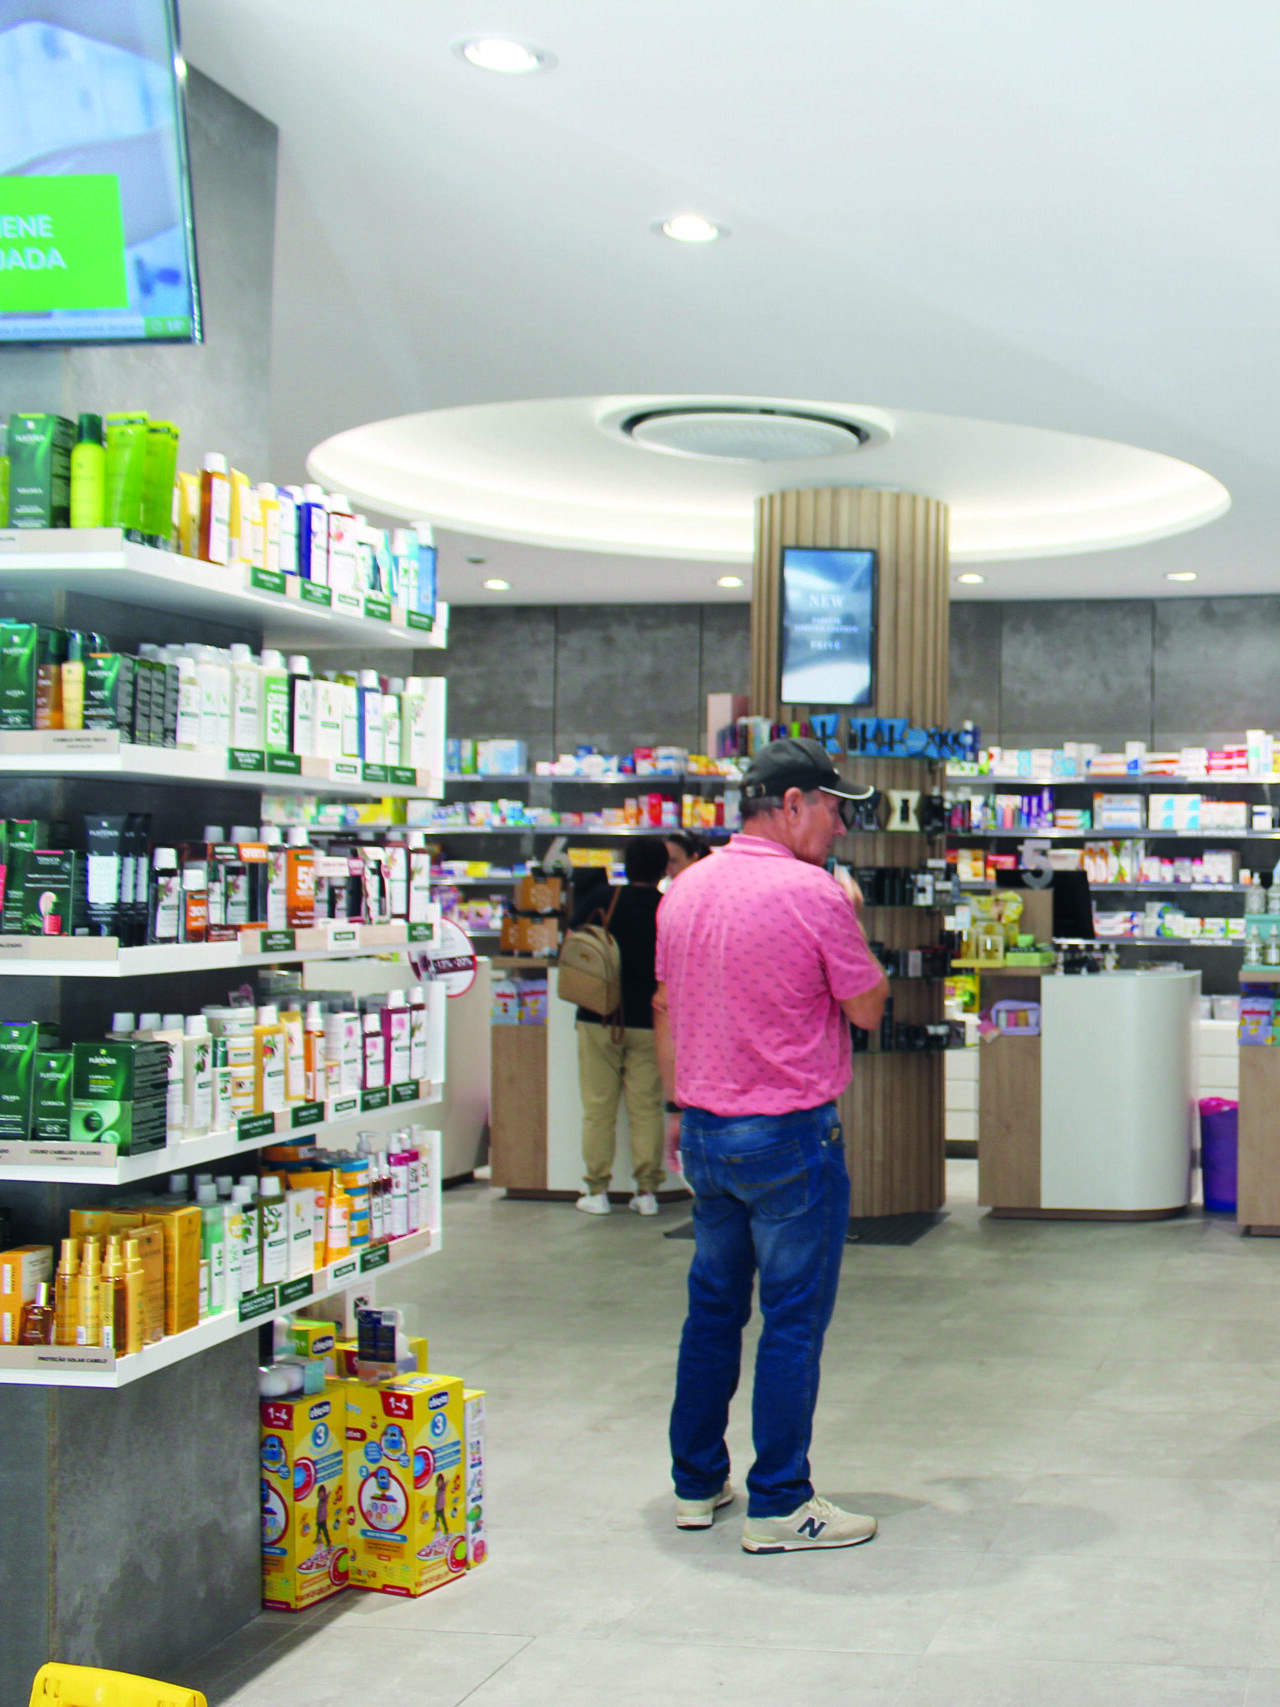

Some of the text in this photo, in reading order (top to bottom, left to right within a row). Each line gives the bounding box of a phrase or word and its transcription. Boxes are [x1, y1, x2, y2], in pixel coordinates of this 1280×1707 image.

[0, 215, 54, 238] ENE
[809, 593, 846, 608] NEW
[1021, 839, 1053, 890] 5
[315, 1424, 326, 1444] 3
[434, 1415, 444, 1434] 3
[796, 1516, 827, 1539] N
